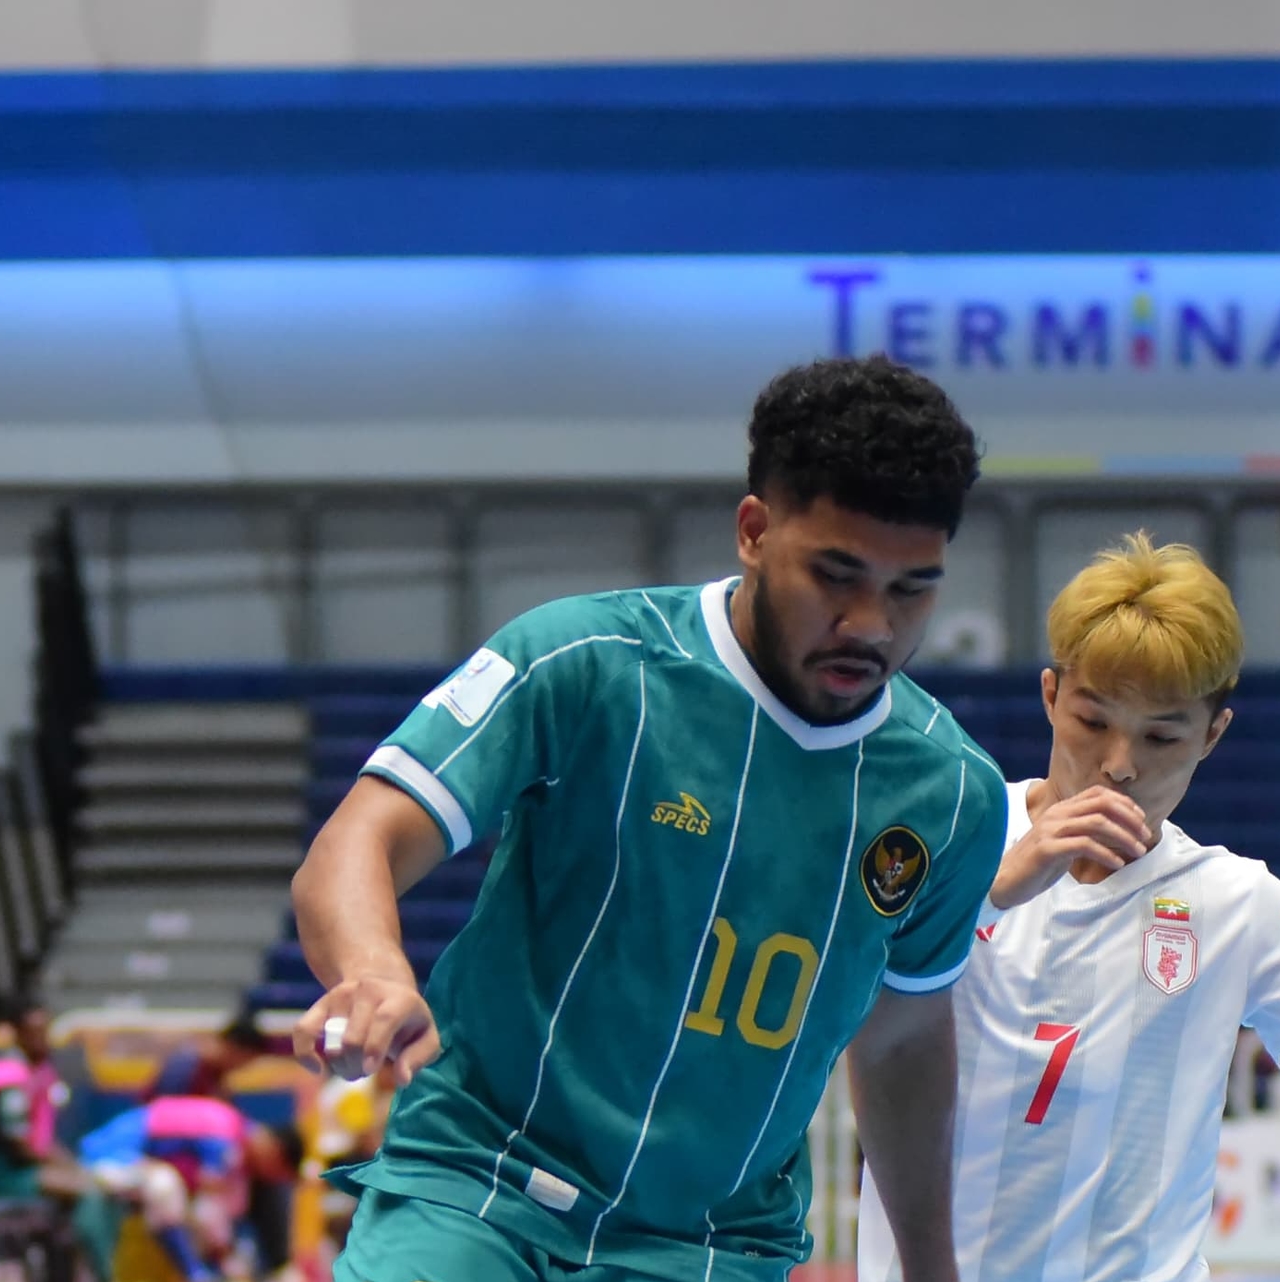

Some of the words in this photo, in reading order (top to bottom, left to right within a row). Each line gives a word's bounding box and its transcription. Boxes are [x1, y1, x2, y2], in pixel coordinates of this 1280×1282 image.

[650, 805, 711, 836] SPECS
[684, 916, 819, 1051] 10
[1024, 1022, 1082, 1126] 7
